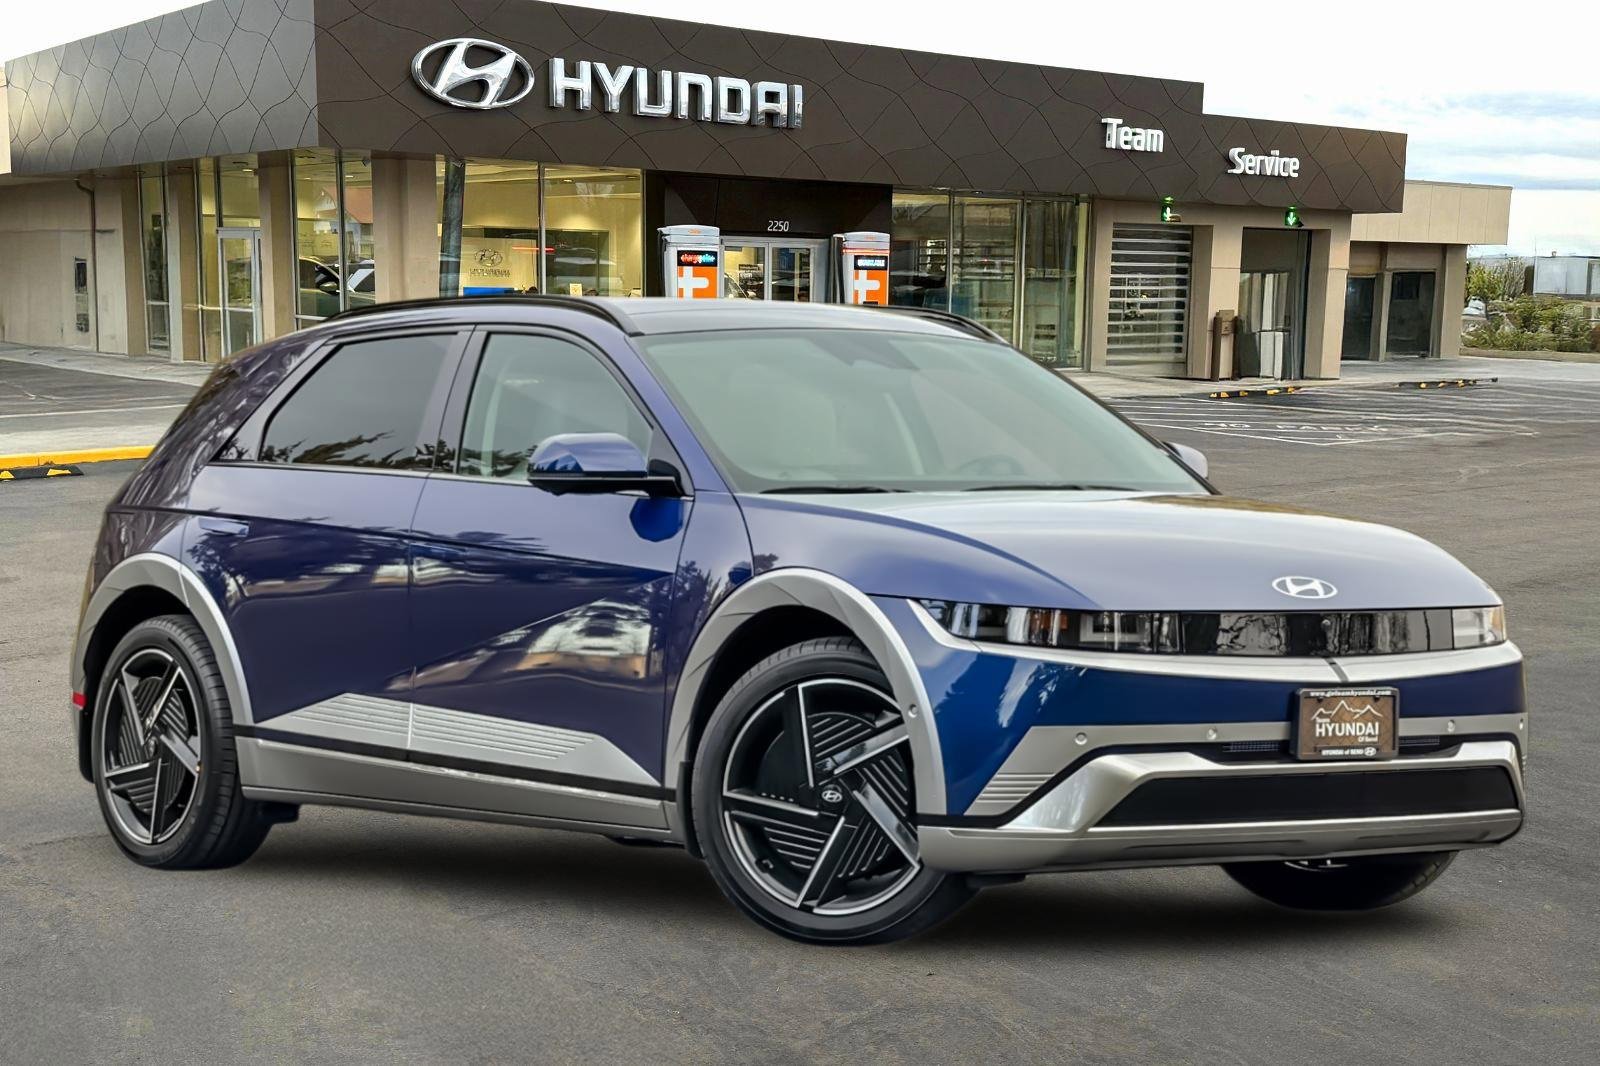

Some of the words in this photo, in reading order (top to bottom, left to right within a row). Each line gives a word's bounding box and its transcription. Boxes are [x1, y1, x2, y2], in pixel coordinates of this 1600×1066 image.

[548, 56, 803, 129] HYUNDAI
[1101, 118, 1164, 153] Team
[1227, 147, 1300, 178] Service
[767, 220, 790, 232] 2250
[1315, 721, 1380, 737] HYUNDAI
